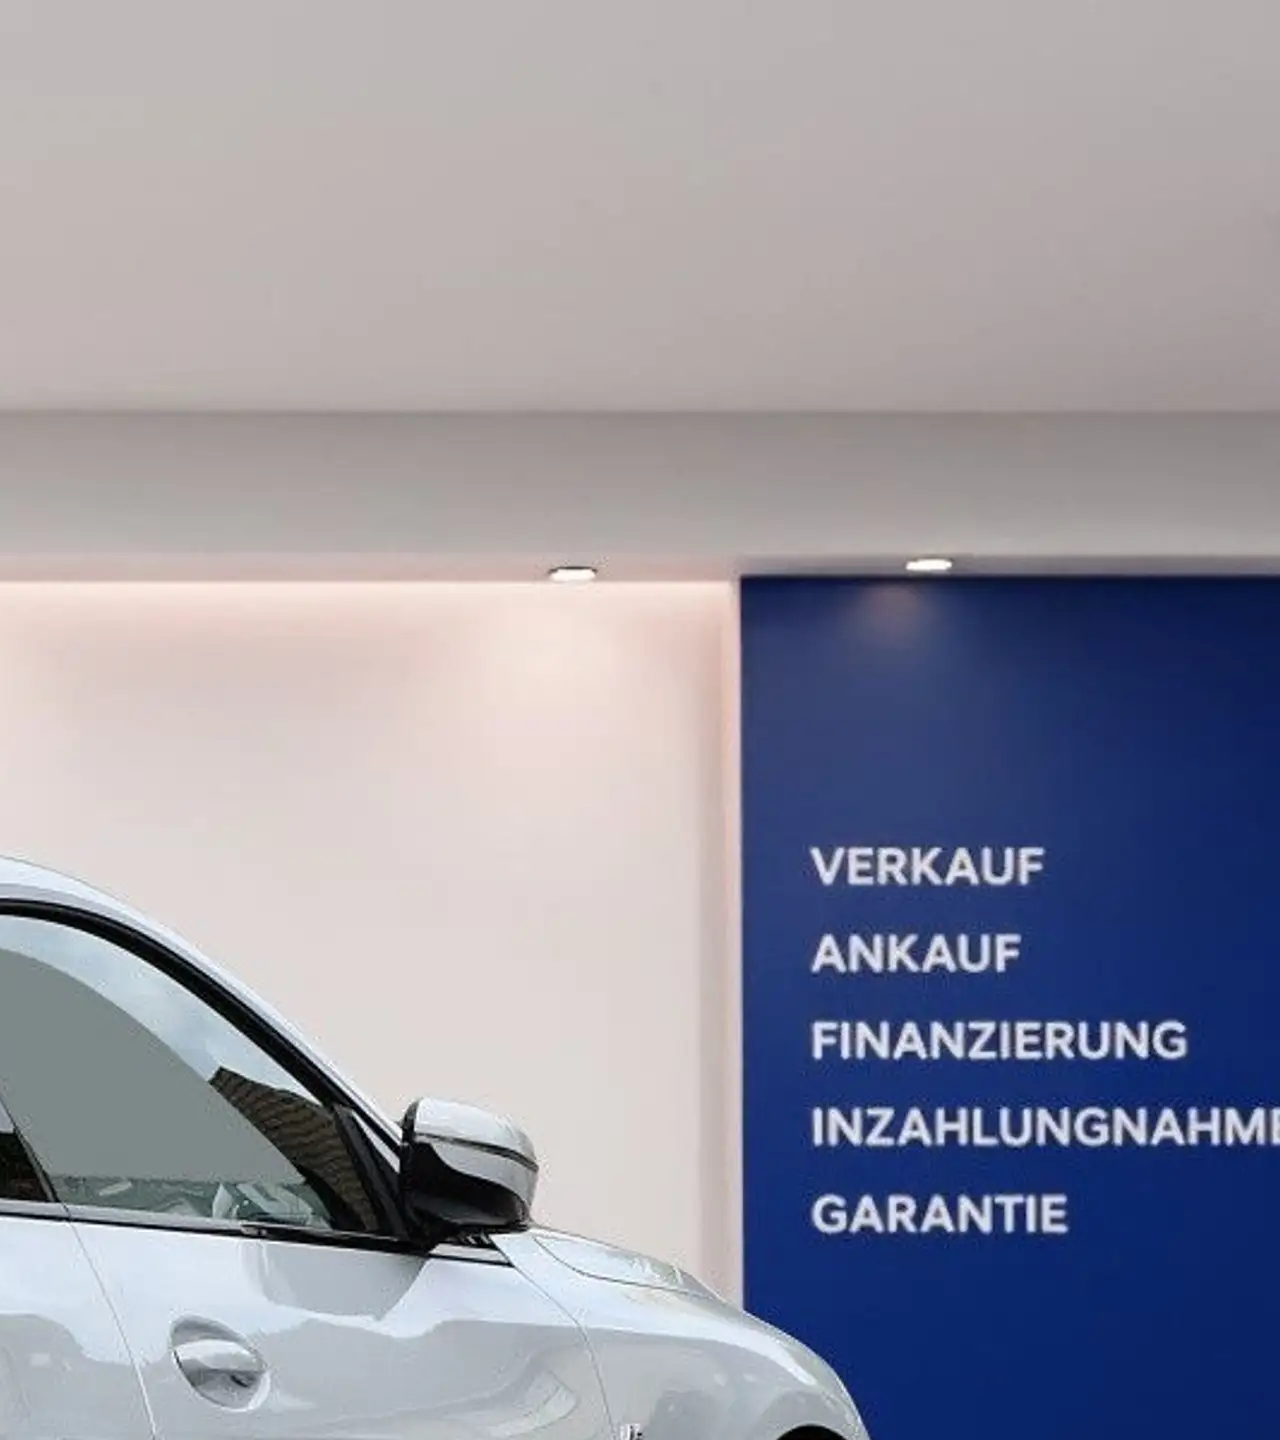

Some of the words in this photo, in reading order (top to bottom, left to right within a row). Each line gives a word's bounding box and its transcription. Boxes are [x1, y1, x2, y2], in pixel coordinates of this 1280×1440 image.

[810, 846, 1044, 886] VERKAUF
[811, 933, 1021, 973] ANKAUF
[811, 1021, 1188, 1060] FINANZIERUNG
[811, 1194, 1068, 1234] GARANTIE
